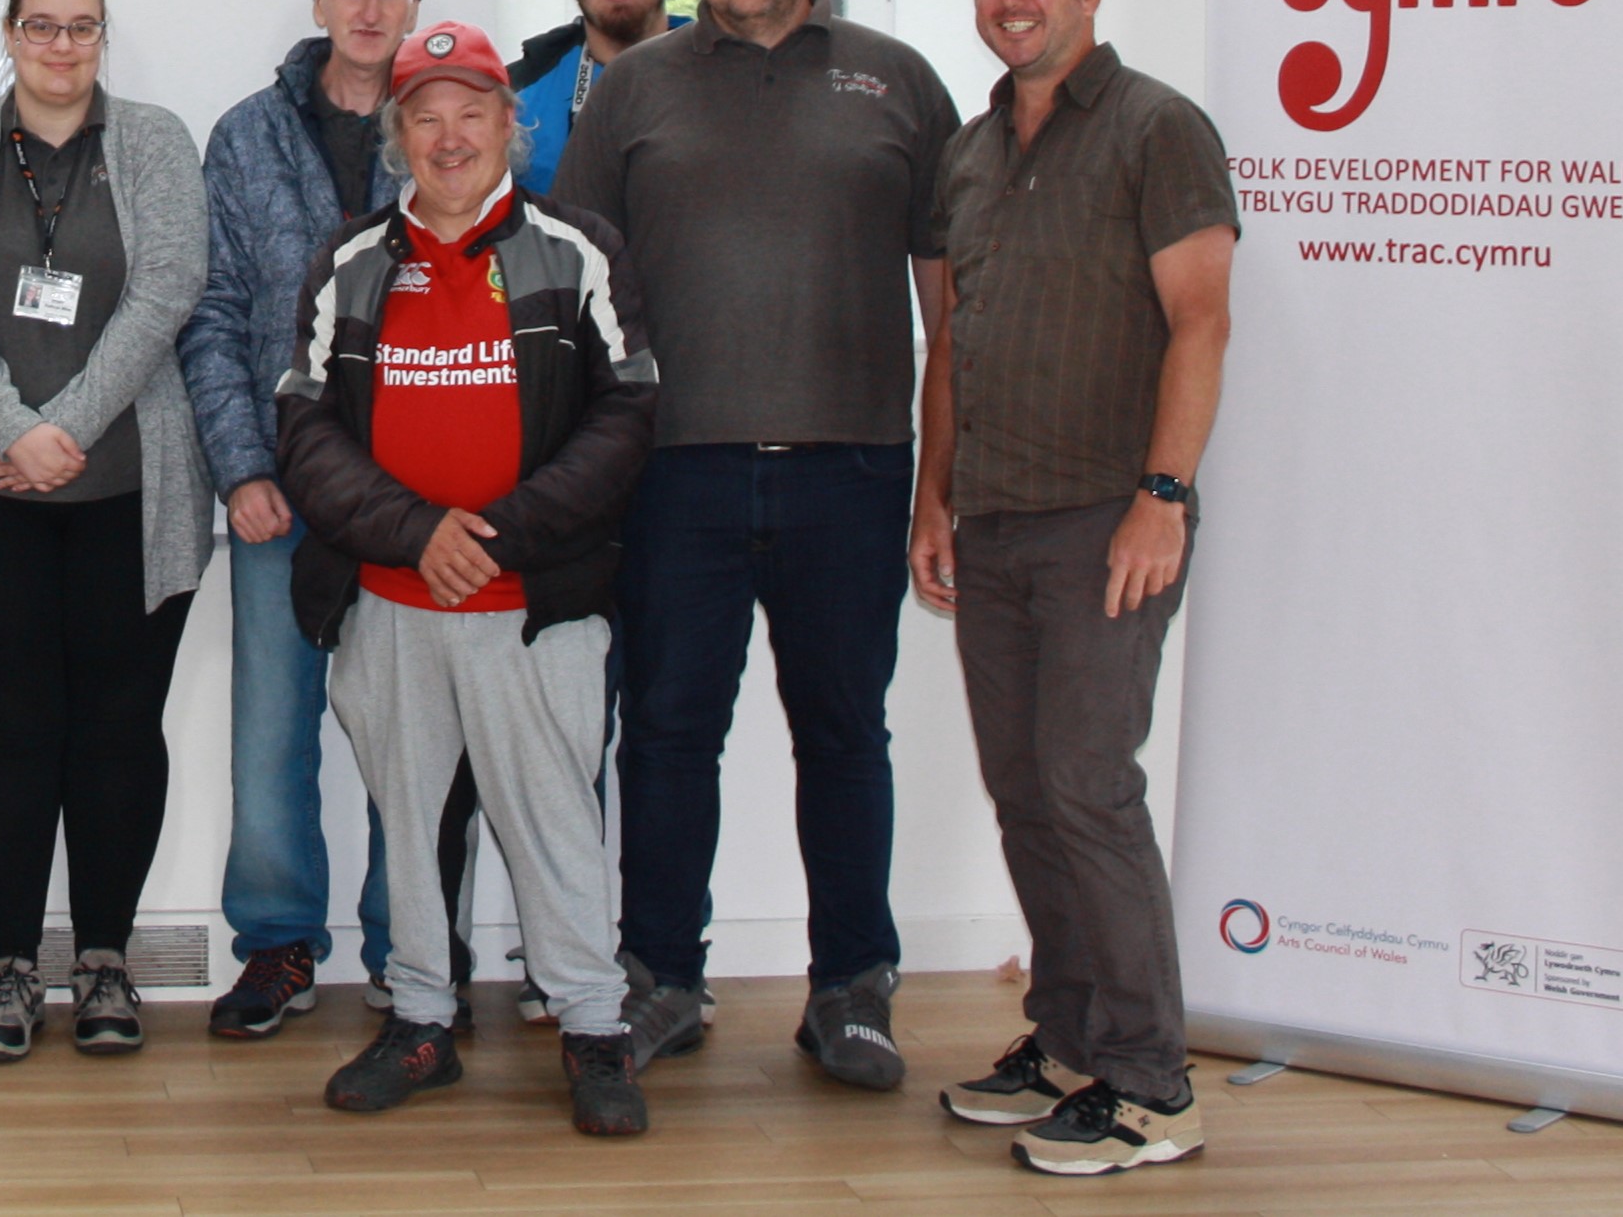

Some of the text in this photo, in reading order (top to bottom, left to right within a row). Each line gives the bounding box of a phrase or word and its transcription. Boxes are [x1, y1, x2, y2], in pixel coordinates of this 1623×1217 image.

[1227, 157, 1622, 184] FOLK DEVELOPMENT FOR WAL
[1238, 190, 1623, 219] TBLYGU TRADDODIADAU GWE
[1299, 239, 1551, 272] www.trac.cymru
[1277, 915, 1322, 933] Cyngor
[1407, 934, 1449, 951] Cymru
[1277, 935, 1408, 964] Arts Council of Wales
